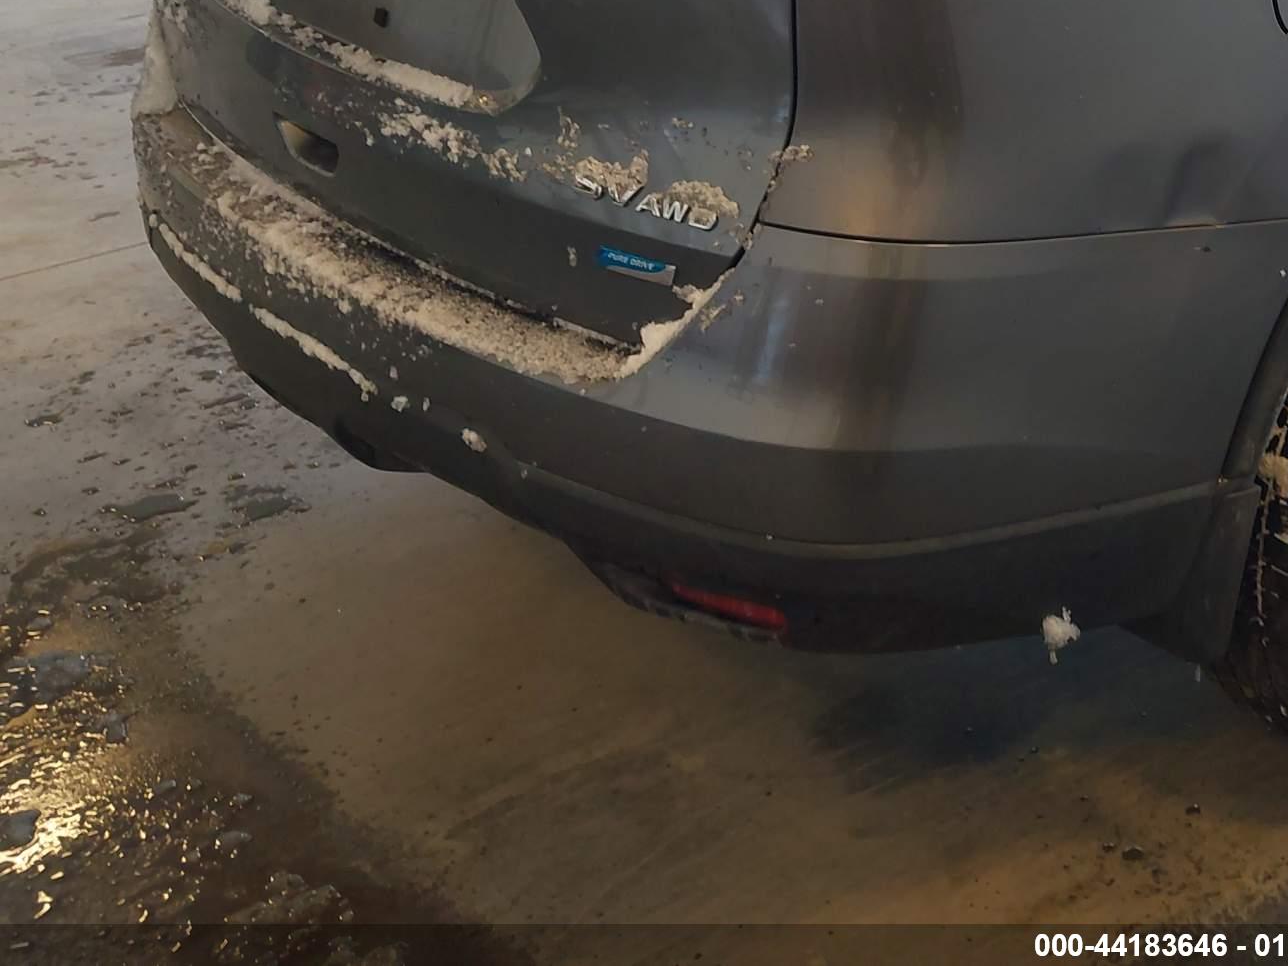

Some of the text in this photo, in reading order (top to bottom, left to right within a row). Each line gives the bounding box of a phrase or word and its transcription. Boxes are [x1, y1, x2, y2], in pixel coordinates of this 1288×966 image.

[635, 193, 718, 231] AWD
[607, 251, 656, 271] PURE DRIVE
